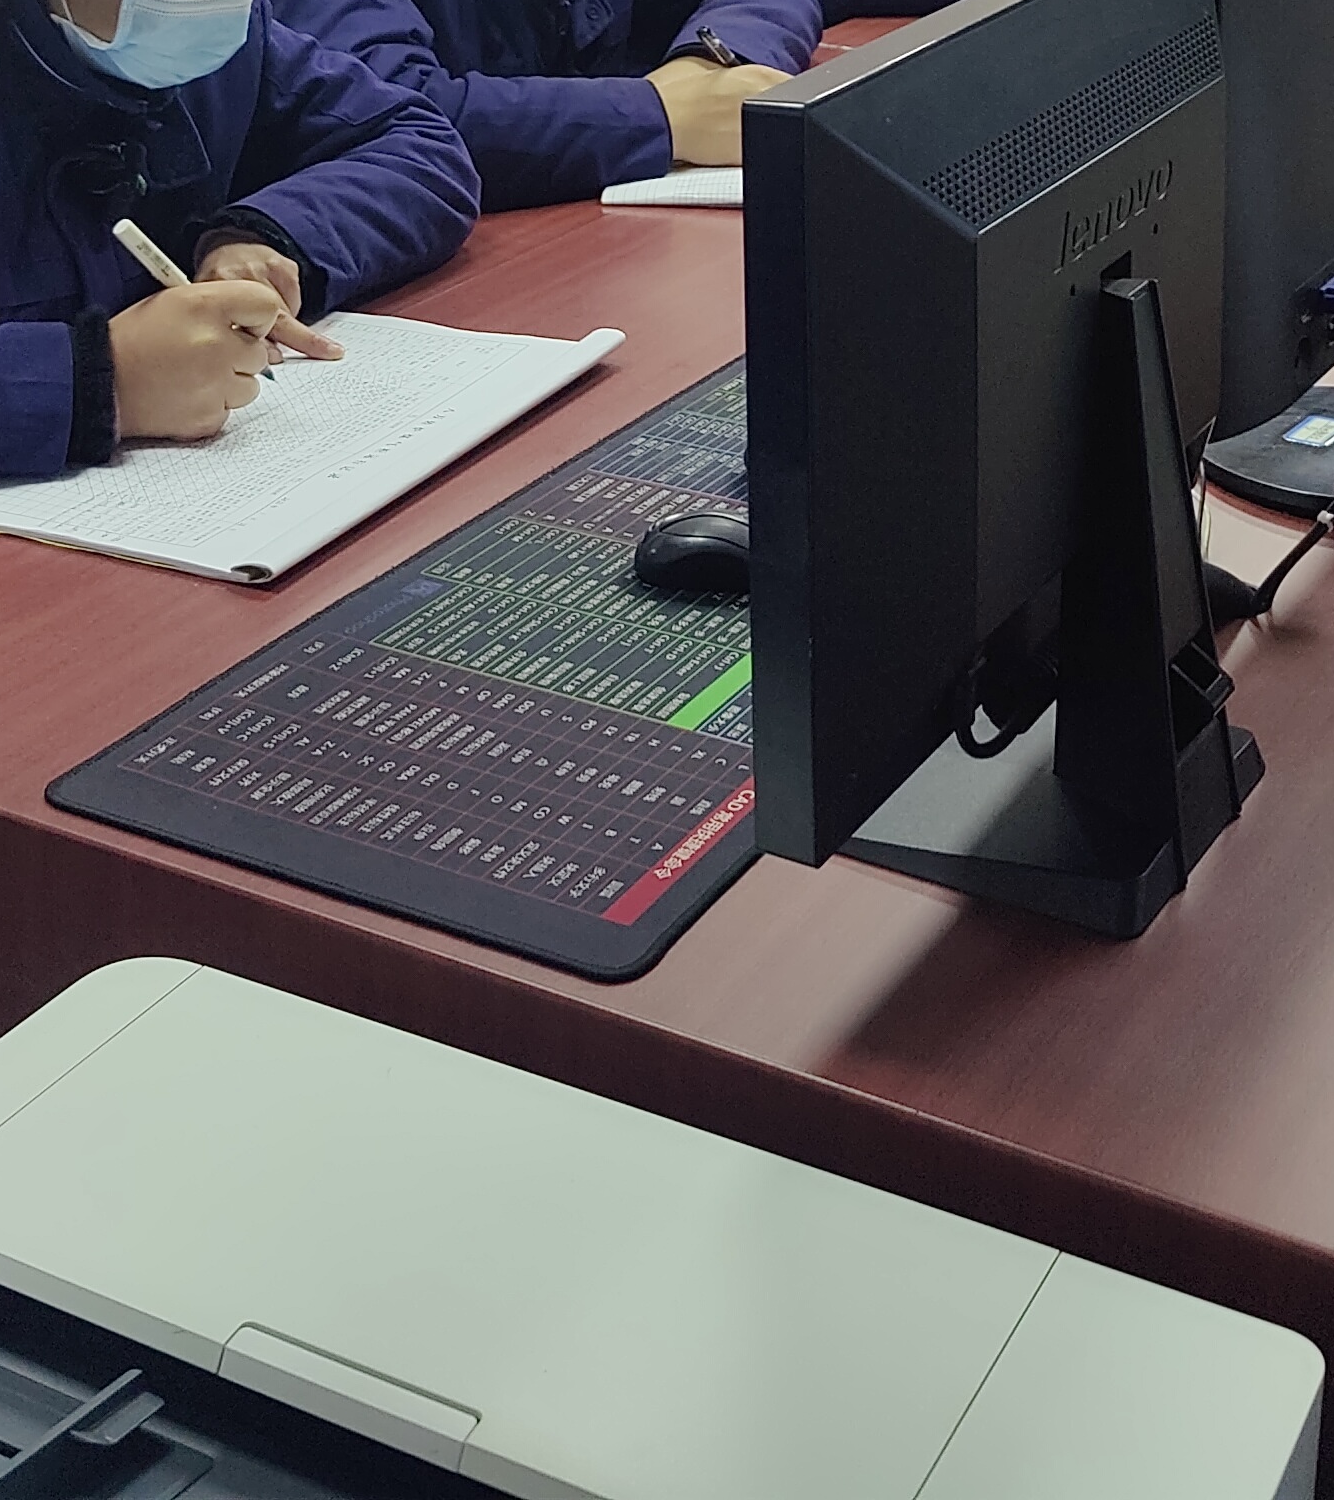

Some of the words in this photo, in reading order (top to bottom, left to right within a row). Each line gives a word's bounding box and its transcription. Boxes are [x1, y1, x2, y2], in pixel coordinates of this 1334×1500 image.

[1053, 159, 1175, 275] lenovo
[722, 787, 756, 812] CAD
[648, 808, 736, 881] 常用快捷键命令
